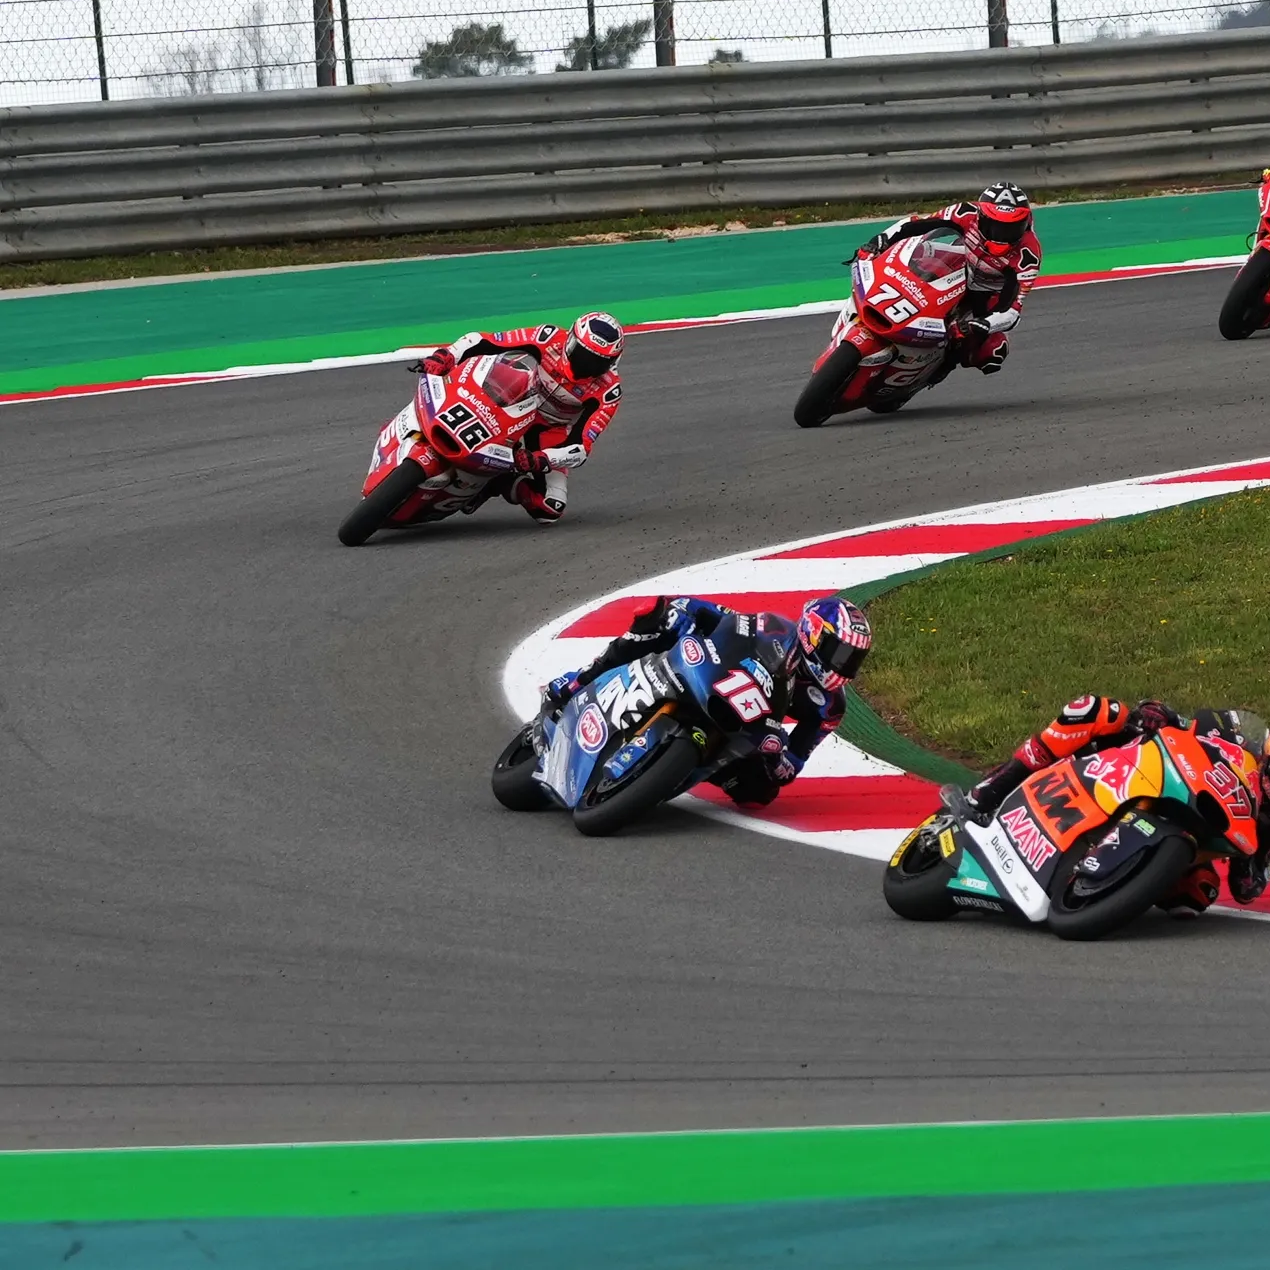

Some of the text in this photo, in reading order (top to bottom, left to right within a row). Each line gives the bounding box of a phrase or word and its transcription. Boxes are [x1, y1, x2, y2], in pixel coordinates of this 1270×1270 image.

[866, 283, 920, 324] 75
[936, 284, 967, 306] GASGAS
[434, 402, 493, 454] 96
[507, 413, 536, 436] GASGAS
[685, 641, 699, 662] PATA
[713, 668, 772, 723] 16
[582, 713, 599, 742] PATA
[1030, 771, 1086, 834] KTM
[1204, 761, 1252, 819] 37
[991, 836, 1010, 864] Duell
[1001, 806, 1057, 872] AVANT
